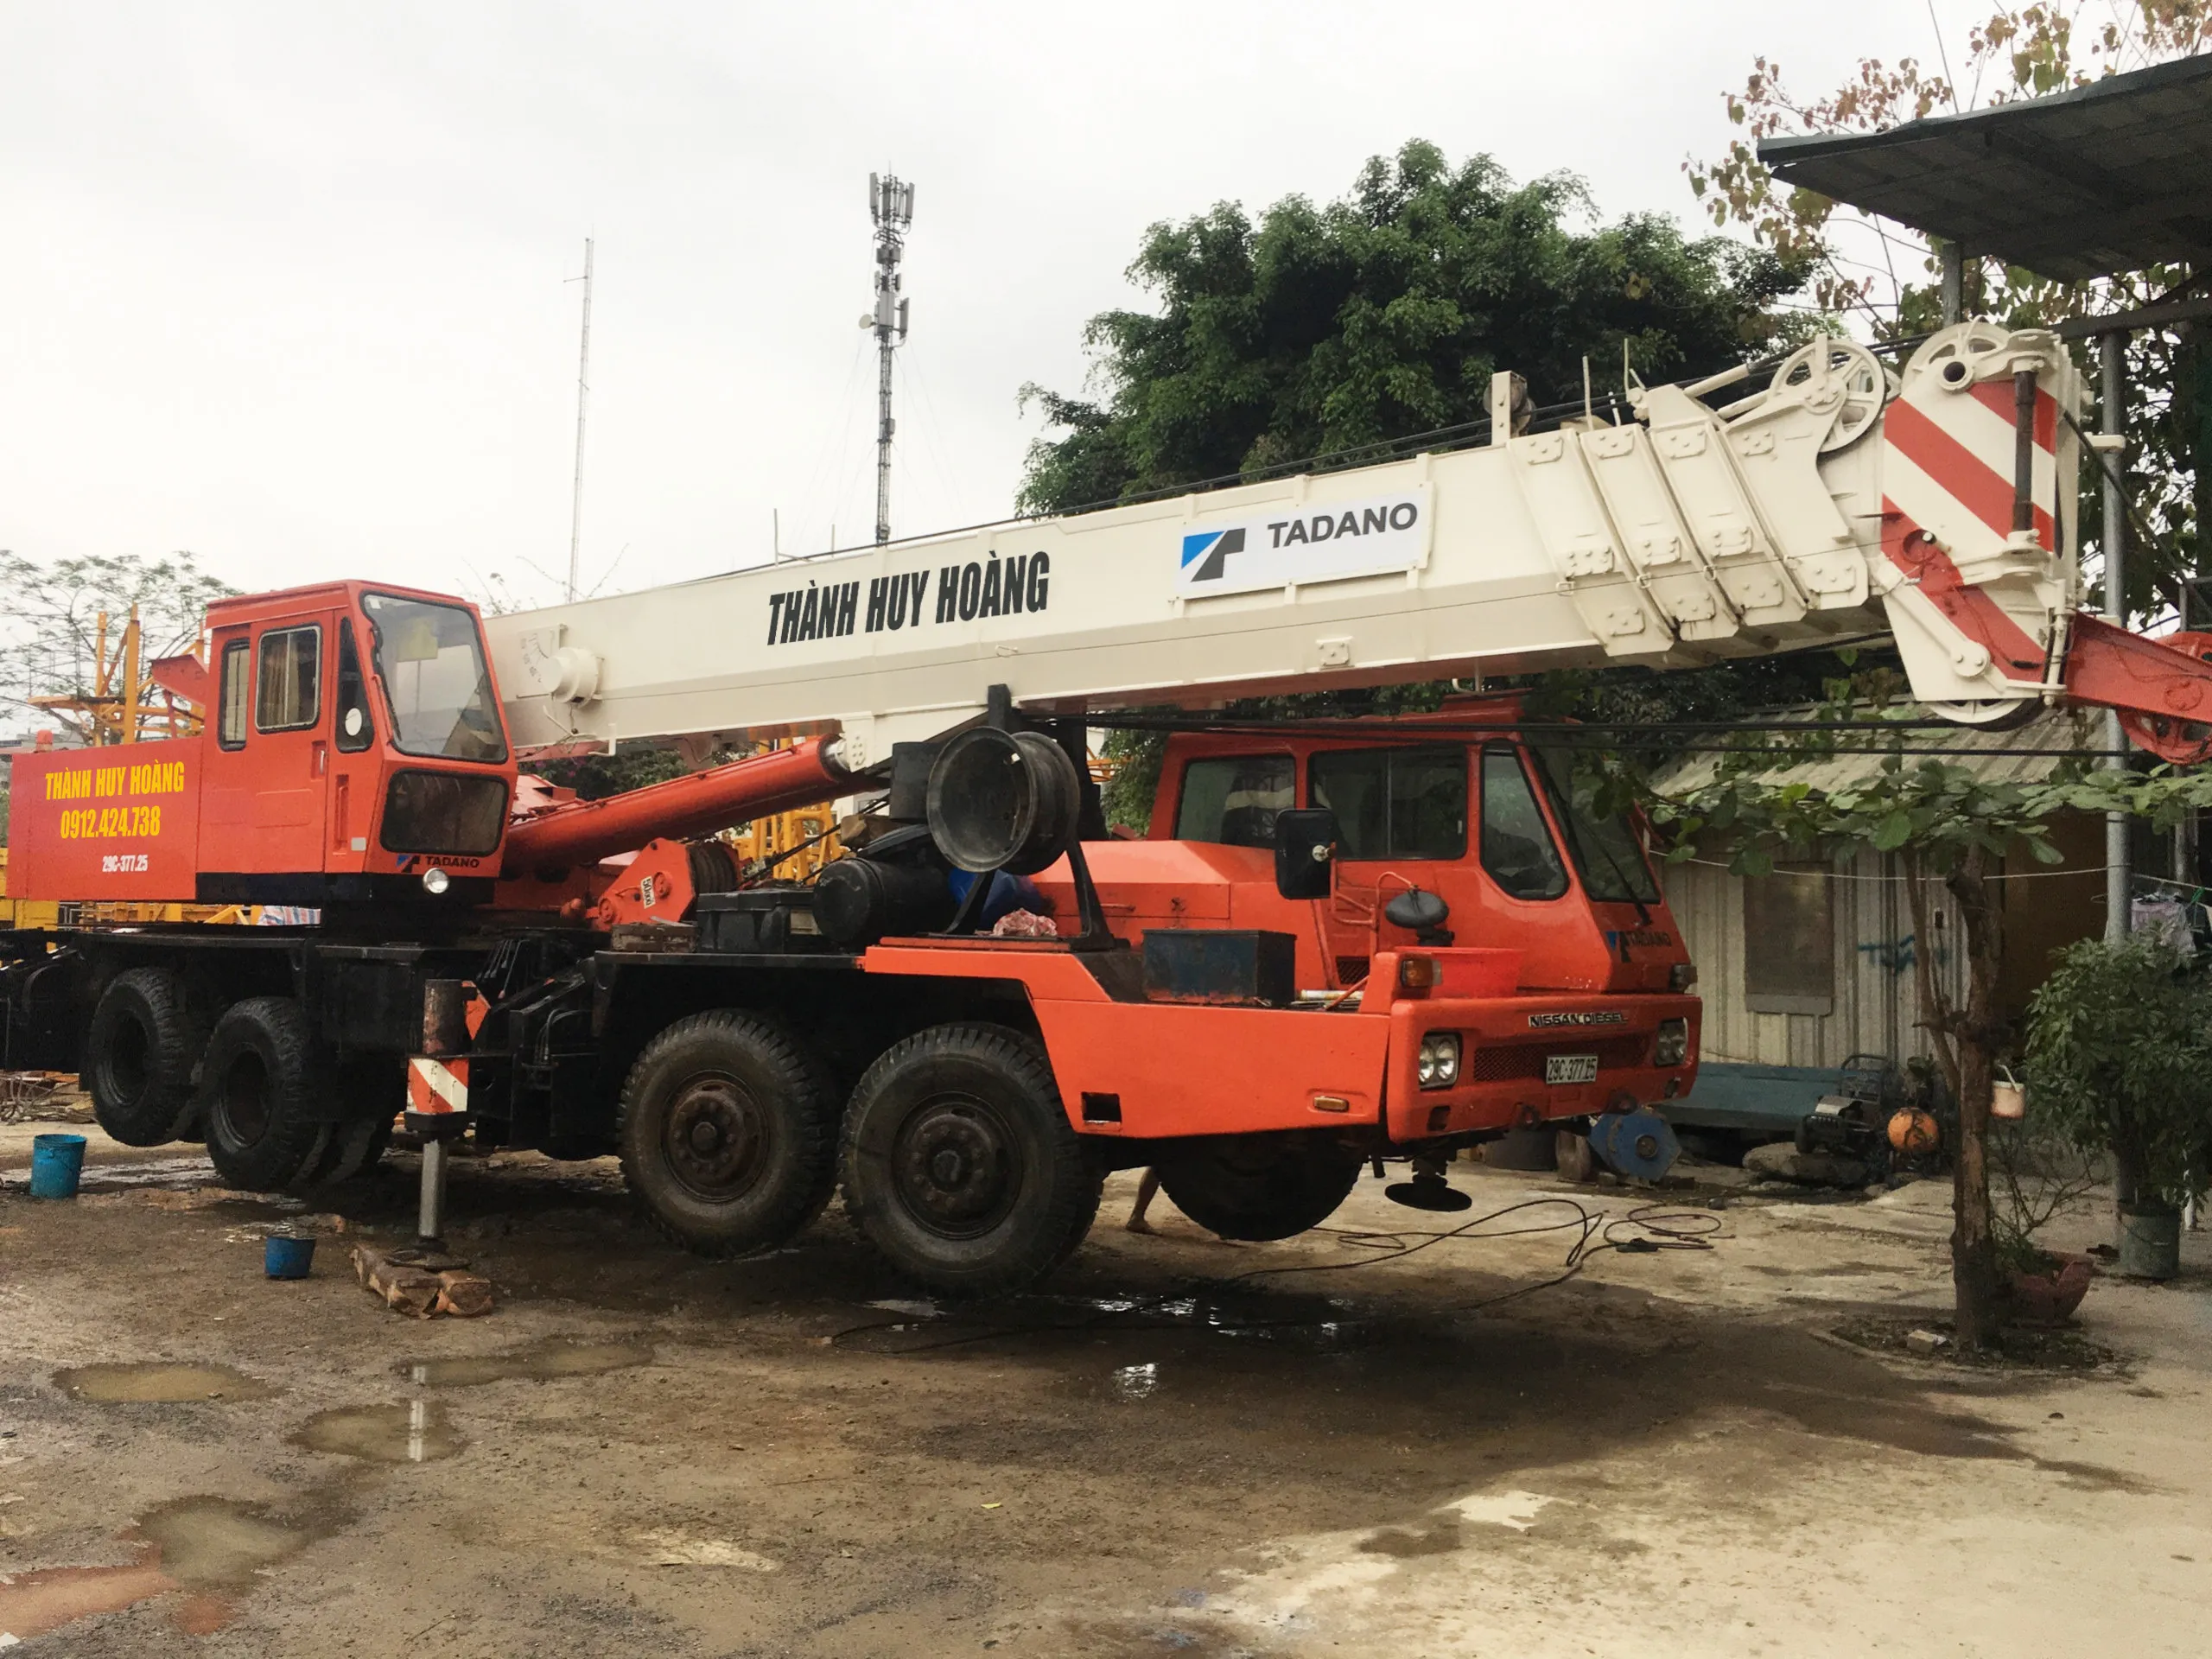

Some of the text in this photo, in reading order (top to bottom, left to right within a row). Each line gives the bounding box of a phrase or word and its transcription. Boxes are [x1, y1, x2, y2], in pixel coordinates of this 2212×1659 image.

[1267, 502, 1418, 549] TADANO
[767, 550, 1051, 645] THÀNH HUY HOÀNG
[45, 759, 185, 800] THÀNH HUY HOÀNG
[60, 805, 161, 839] 0912.424.738
[425, 855, 480, 868] TADANO
[1529, 1011, 1628, 1027] NISSAN DIESEL
